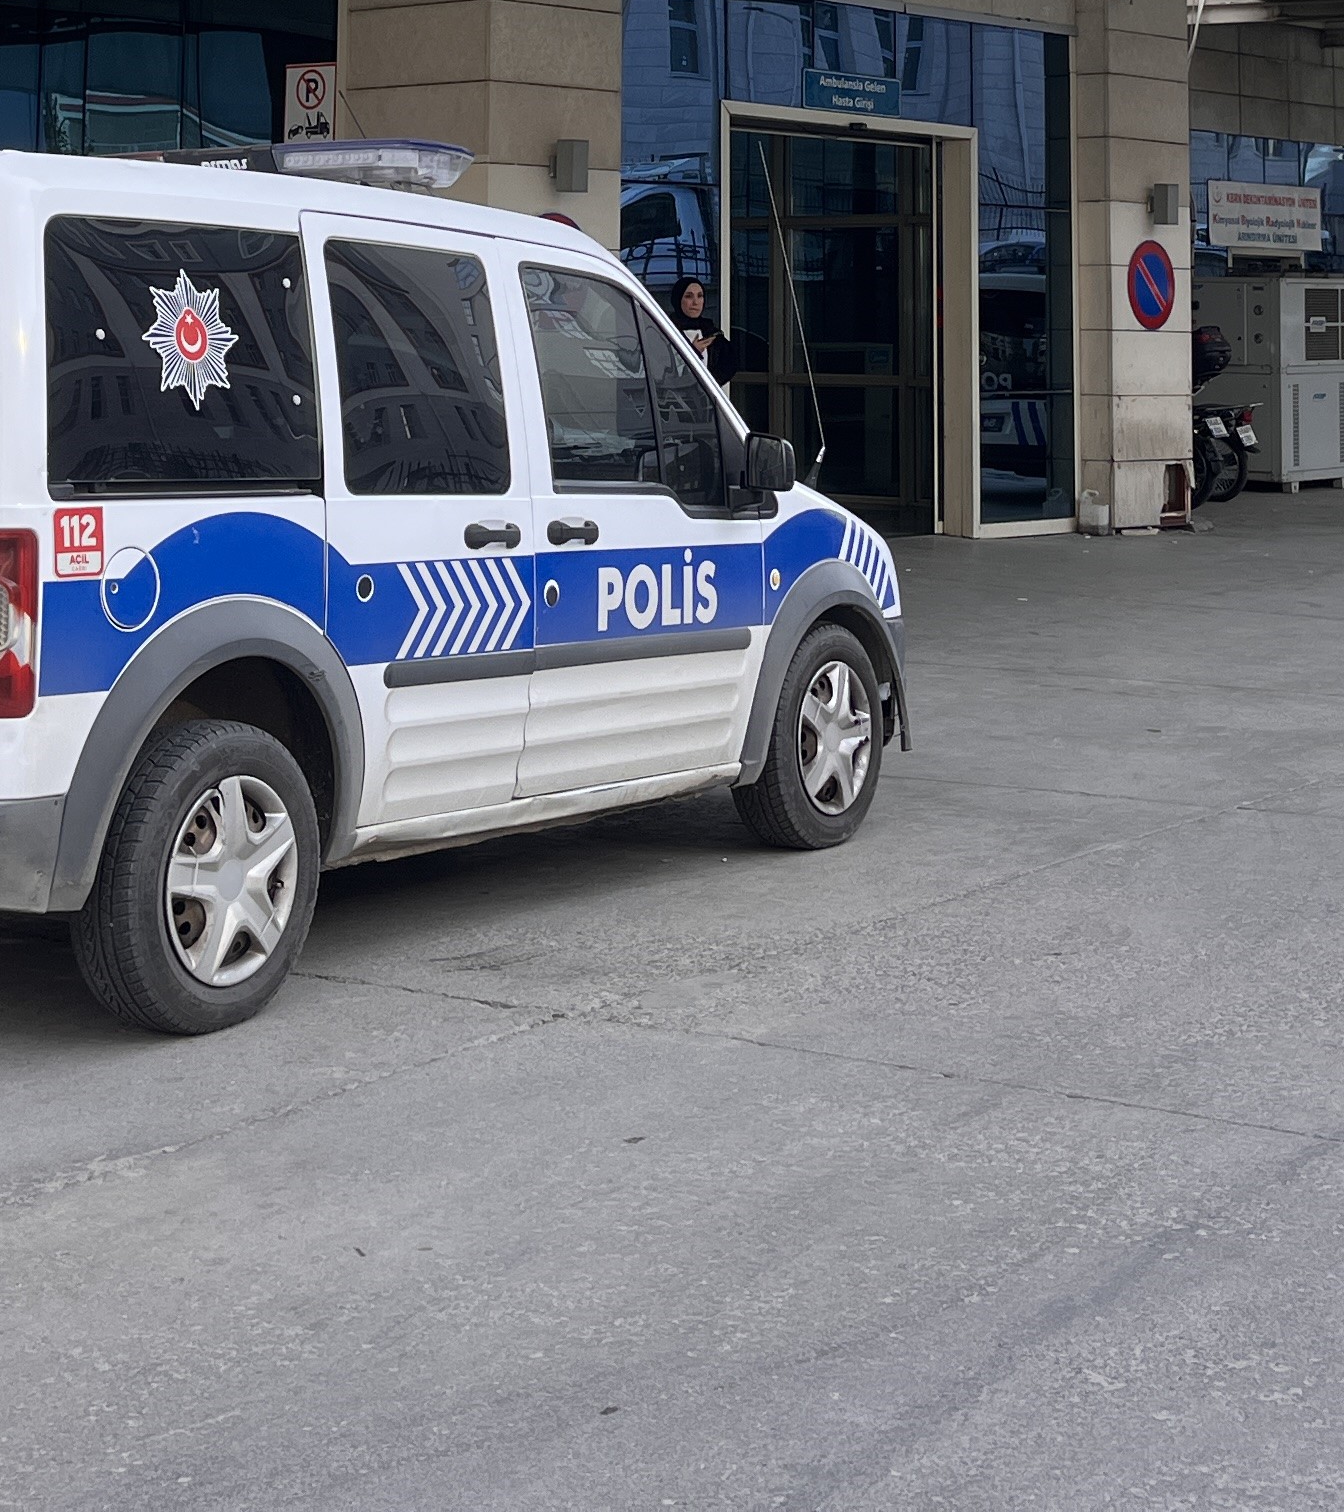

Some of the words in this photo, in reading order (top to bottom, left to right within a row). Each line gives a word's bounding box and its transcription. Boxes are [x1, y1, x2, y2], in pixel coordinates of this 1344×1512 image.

[819, 75, 863, 90] Ambulansla
[864, 81, 886, 93] Gelen
[832, 94, 854, 107] Hasta
[60, 514, 97, 548] 112
[597, 548, 718, 632] POLİS
